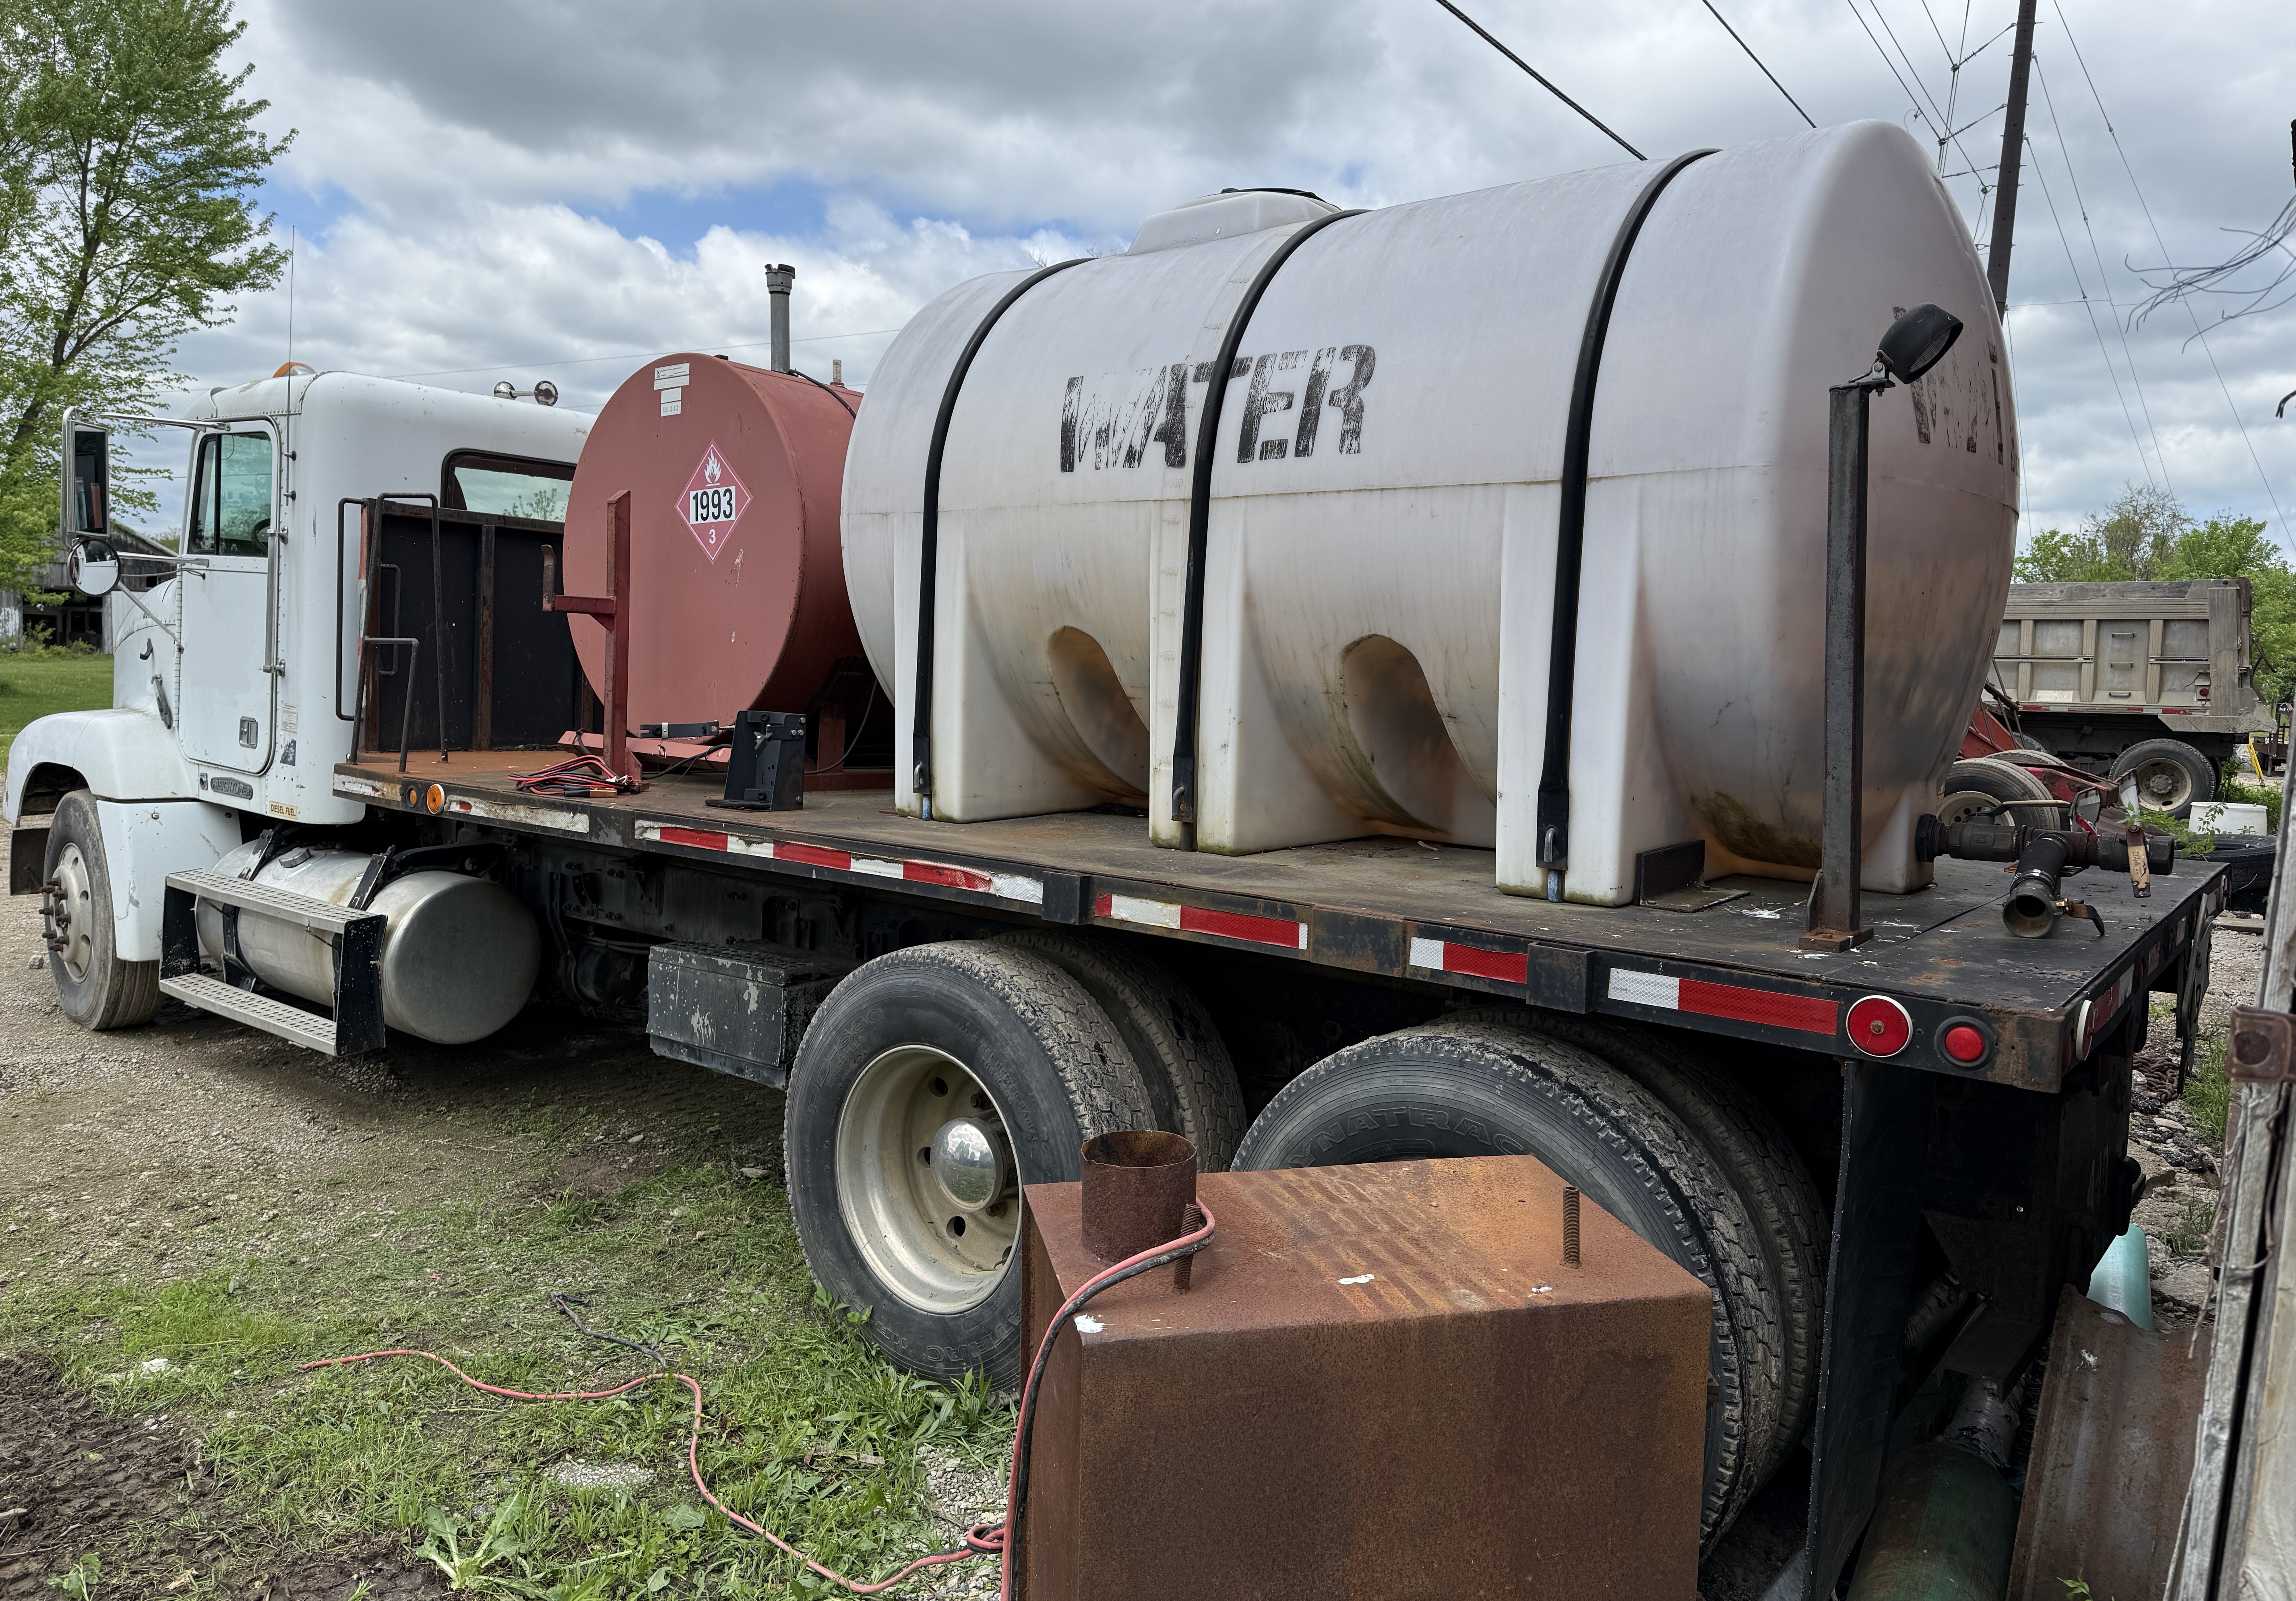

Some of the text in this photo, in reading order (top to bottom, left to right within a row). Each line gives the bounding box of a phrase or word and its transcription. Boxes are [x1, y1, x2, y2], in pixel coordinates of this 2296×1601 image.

[692, 488, 733, 522] 1993
[709, 529, 716, 544] 3
[211, 779, 252, 797] FREIGHTLINER
[271, 804, 296, 817] DIESEL FUEL
[1283, 1106, 1525, 1168] YNATRAC
